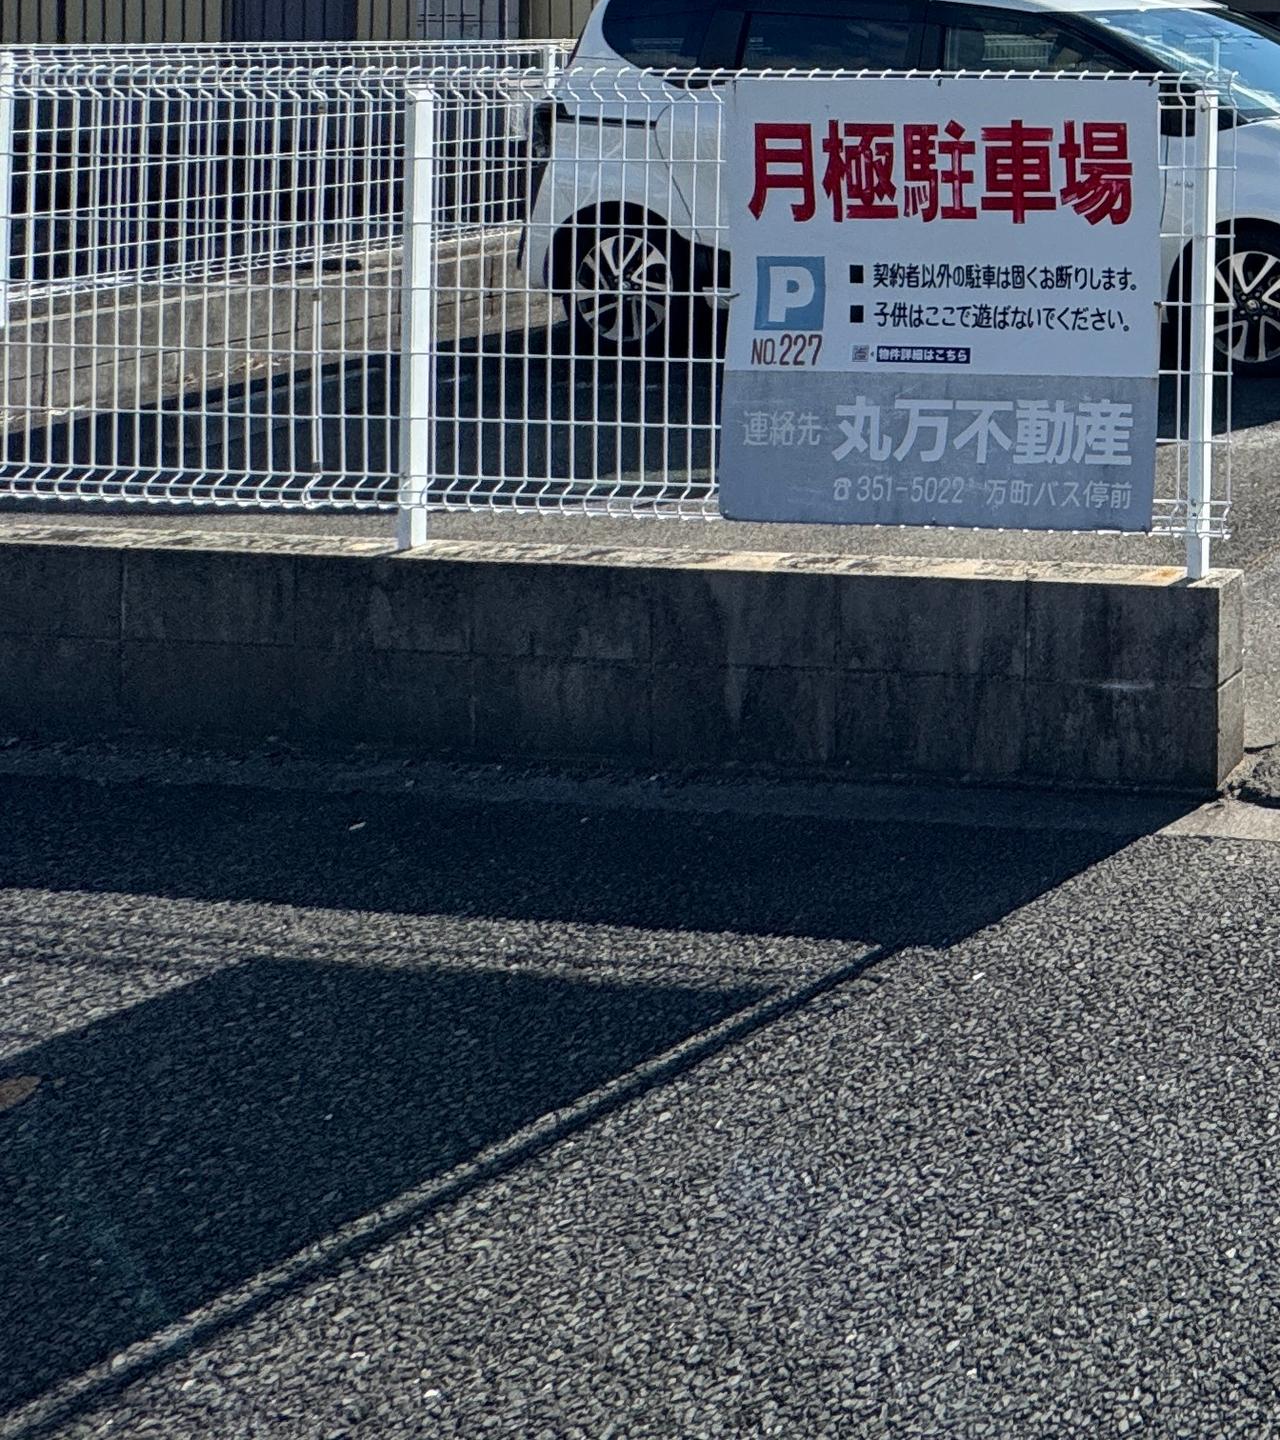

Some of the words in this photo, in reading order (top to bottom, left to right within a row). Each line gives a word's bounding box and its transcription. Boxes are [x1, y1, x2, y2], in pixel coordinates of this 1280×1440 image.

[748, 120, 1133, 226] 月極駐車場
[873, 263, 1138, 292] 契約者以外の駐車は固くお断りします。
[768, 267, 815, 323] P
[873, 303, 1131, 332] 子供はここで遊ばないでください。
[878, 348, 968, 364] 物件詳細はこちら
[743, 410, 822, 447] 連絡先
[832, 396, 1133, 466] 丸万不動産
[986, 478, 1132, 510] 万町バス停前
